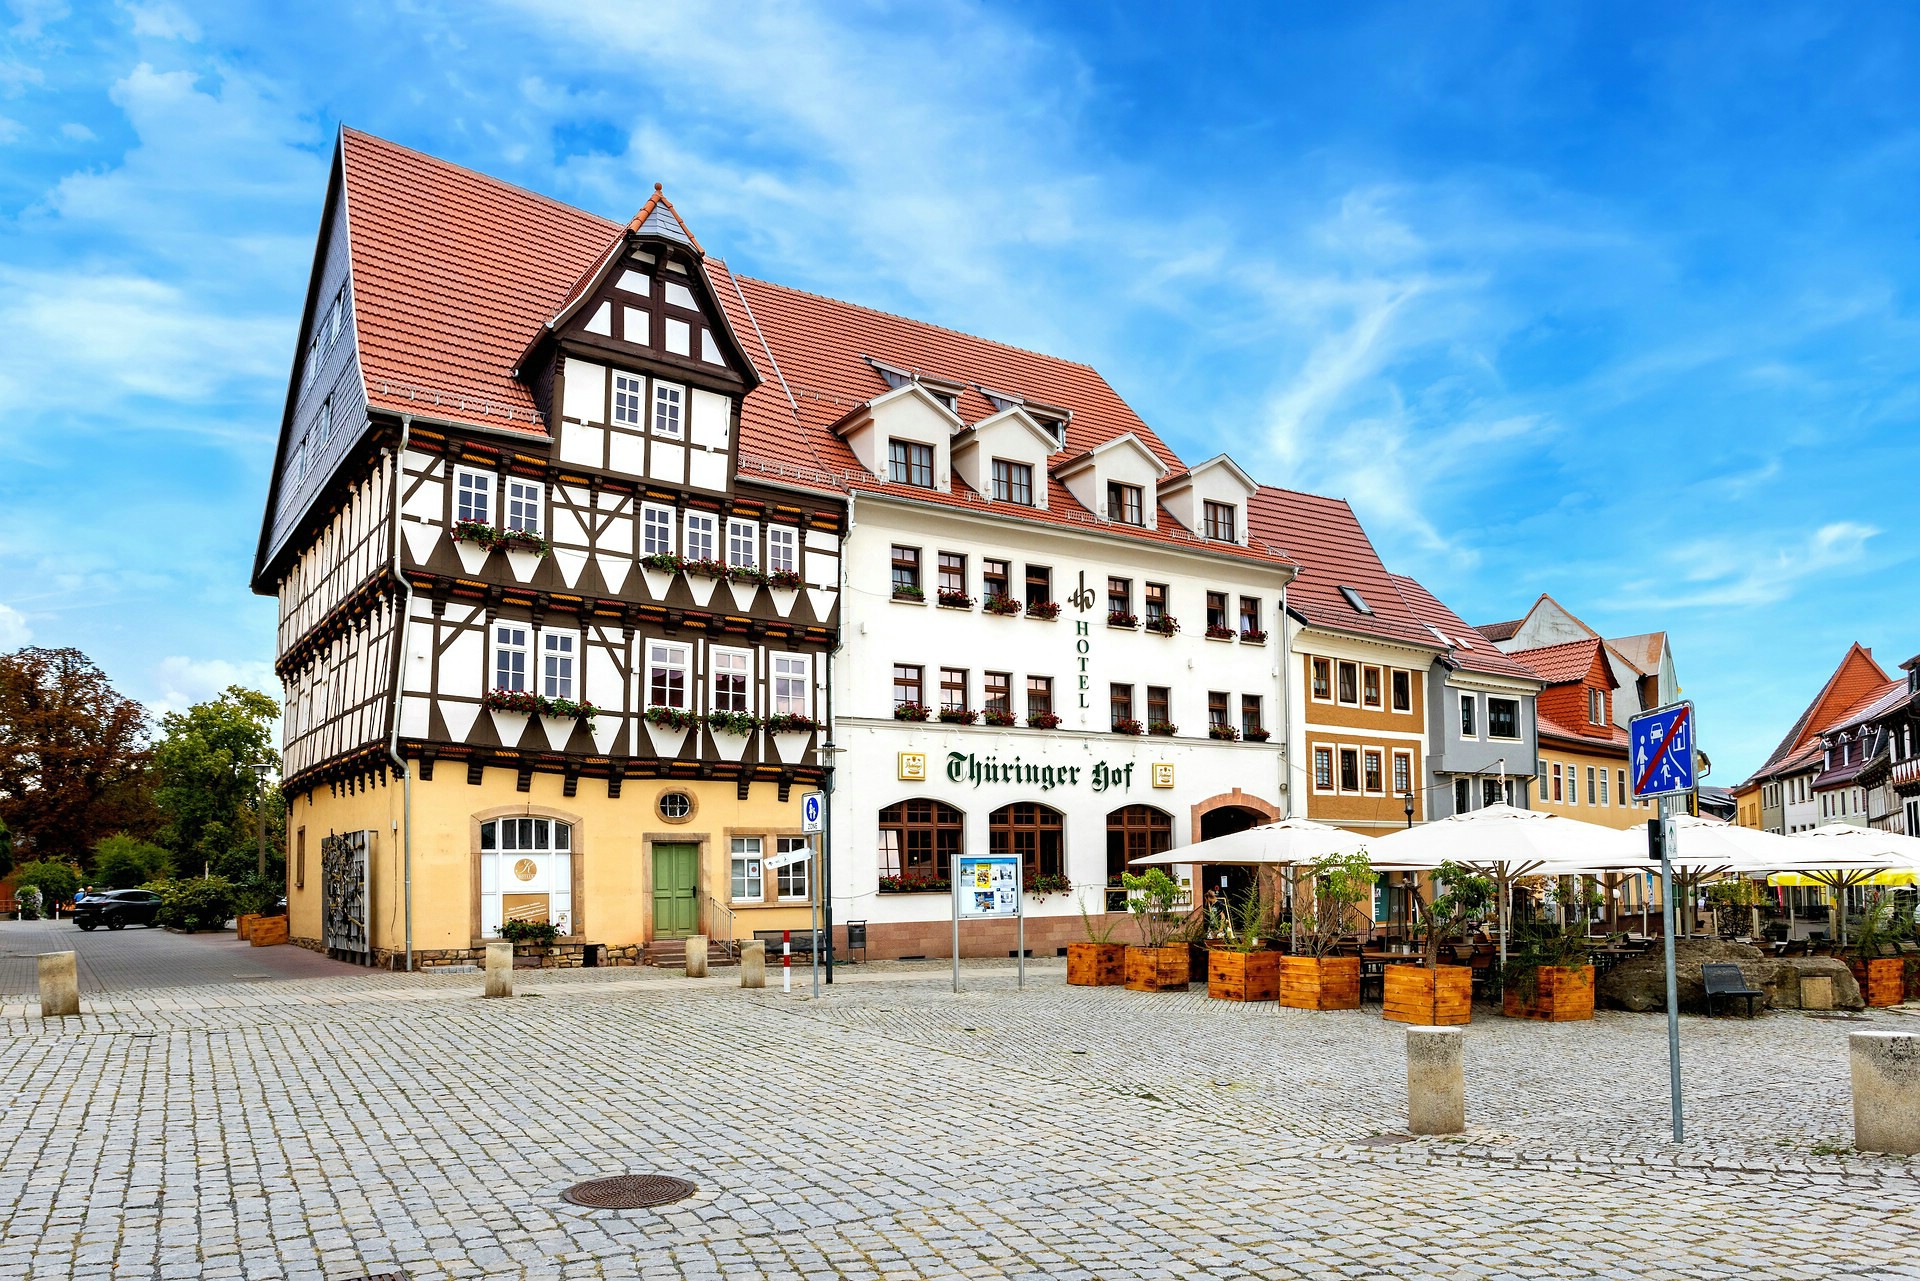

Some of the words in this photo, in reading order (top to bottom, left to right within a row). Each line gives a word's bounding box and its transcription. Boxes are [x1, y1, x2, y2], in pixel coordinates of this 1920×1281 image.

[1076, 620, 1090, 709] HOTEL
[946, 751, 1081, 791] Thüringer
[1092, 760, 1136, 794] Hof
[807, 822, 818, 830] ZONE
